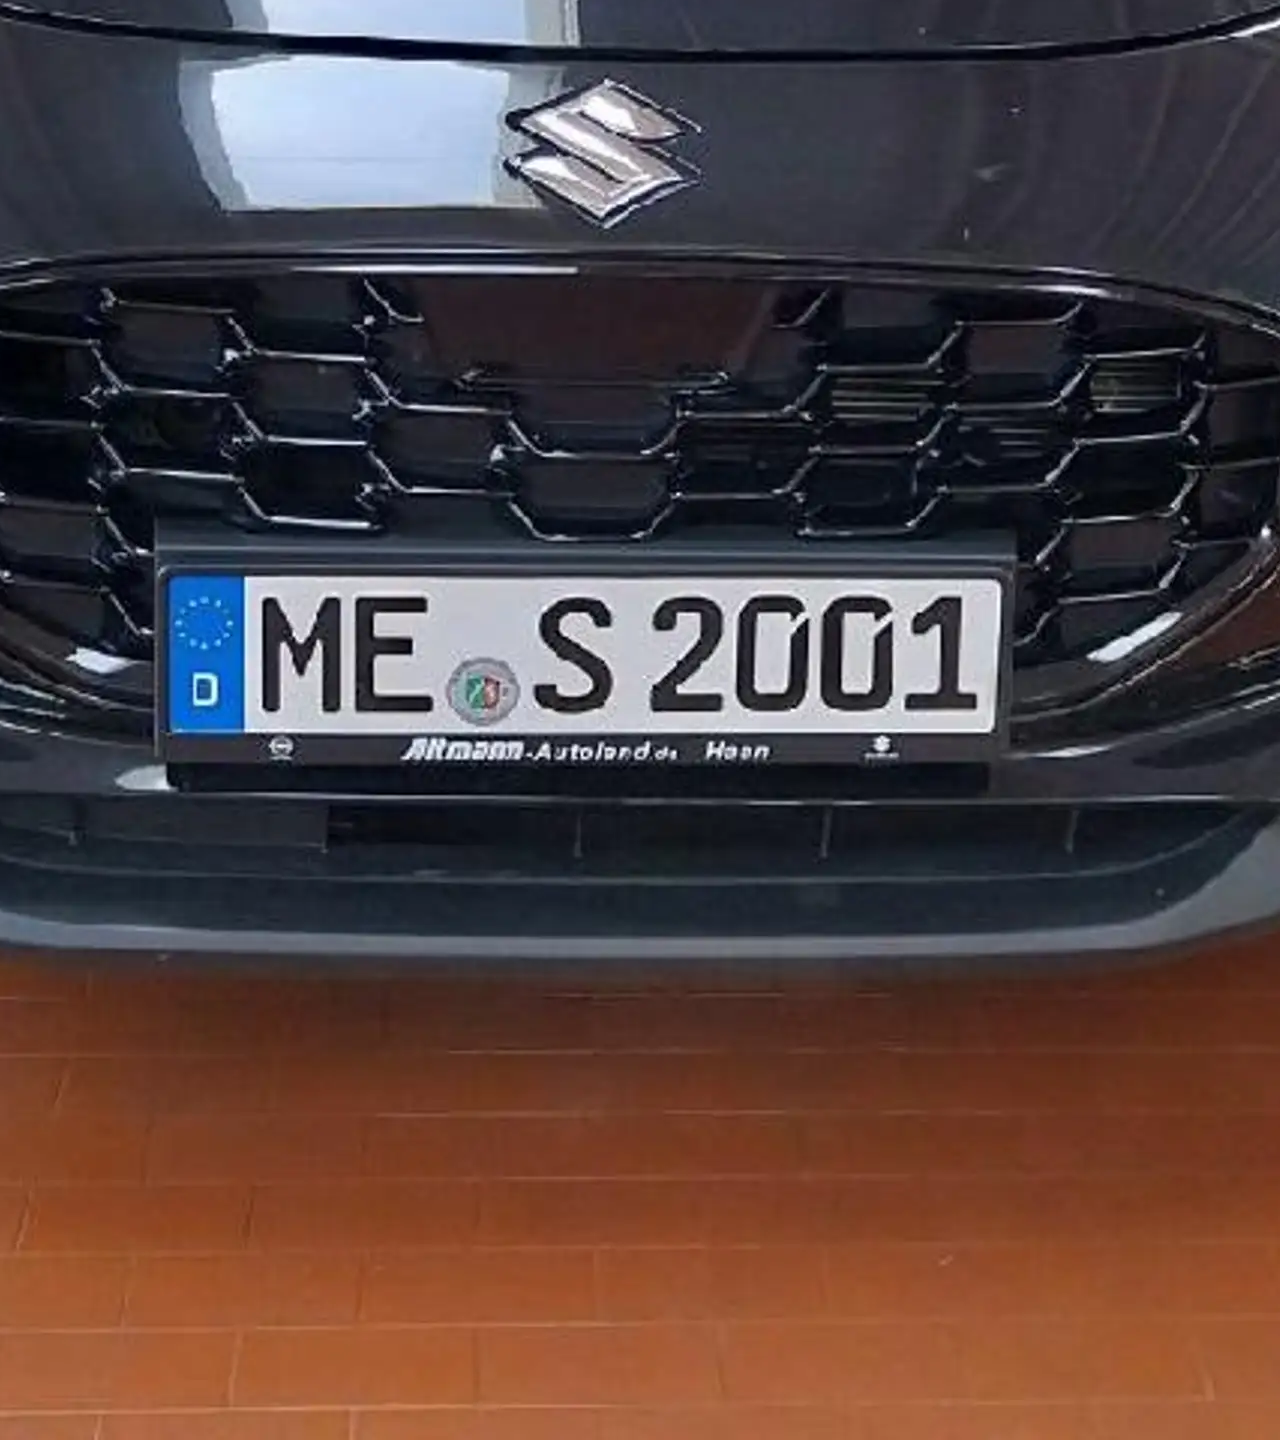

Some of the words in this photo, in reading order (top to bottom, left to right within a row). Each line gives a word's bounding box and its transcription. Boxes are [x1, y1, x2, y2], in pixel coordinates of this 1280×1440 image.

[262, 596, 433, 712] ME
[534, 596, 614, 713] S
[650, 595, 977, 712] 2001
[192, 672, 218, 707] D
[705, 740, 771, 761] Haan
